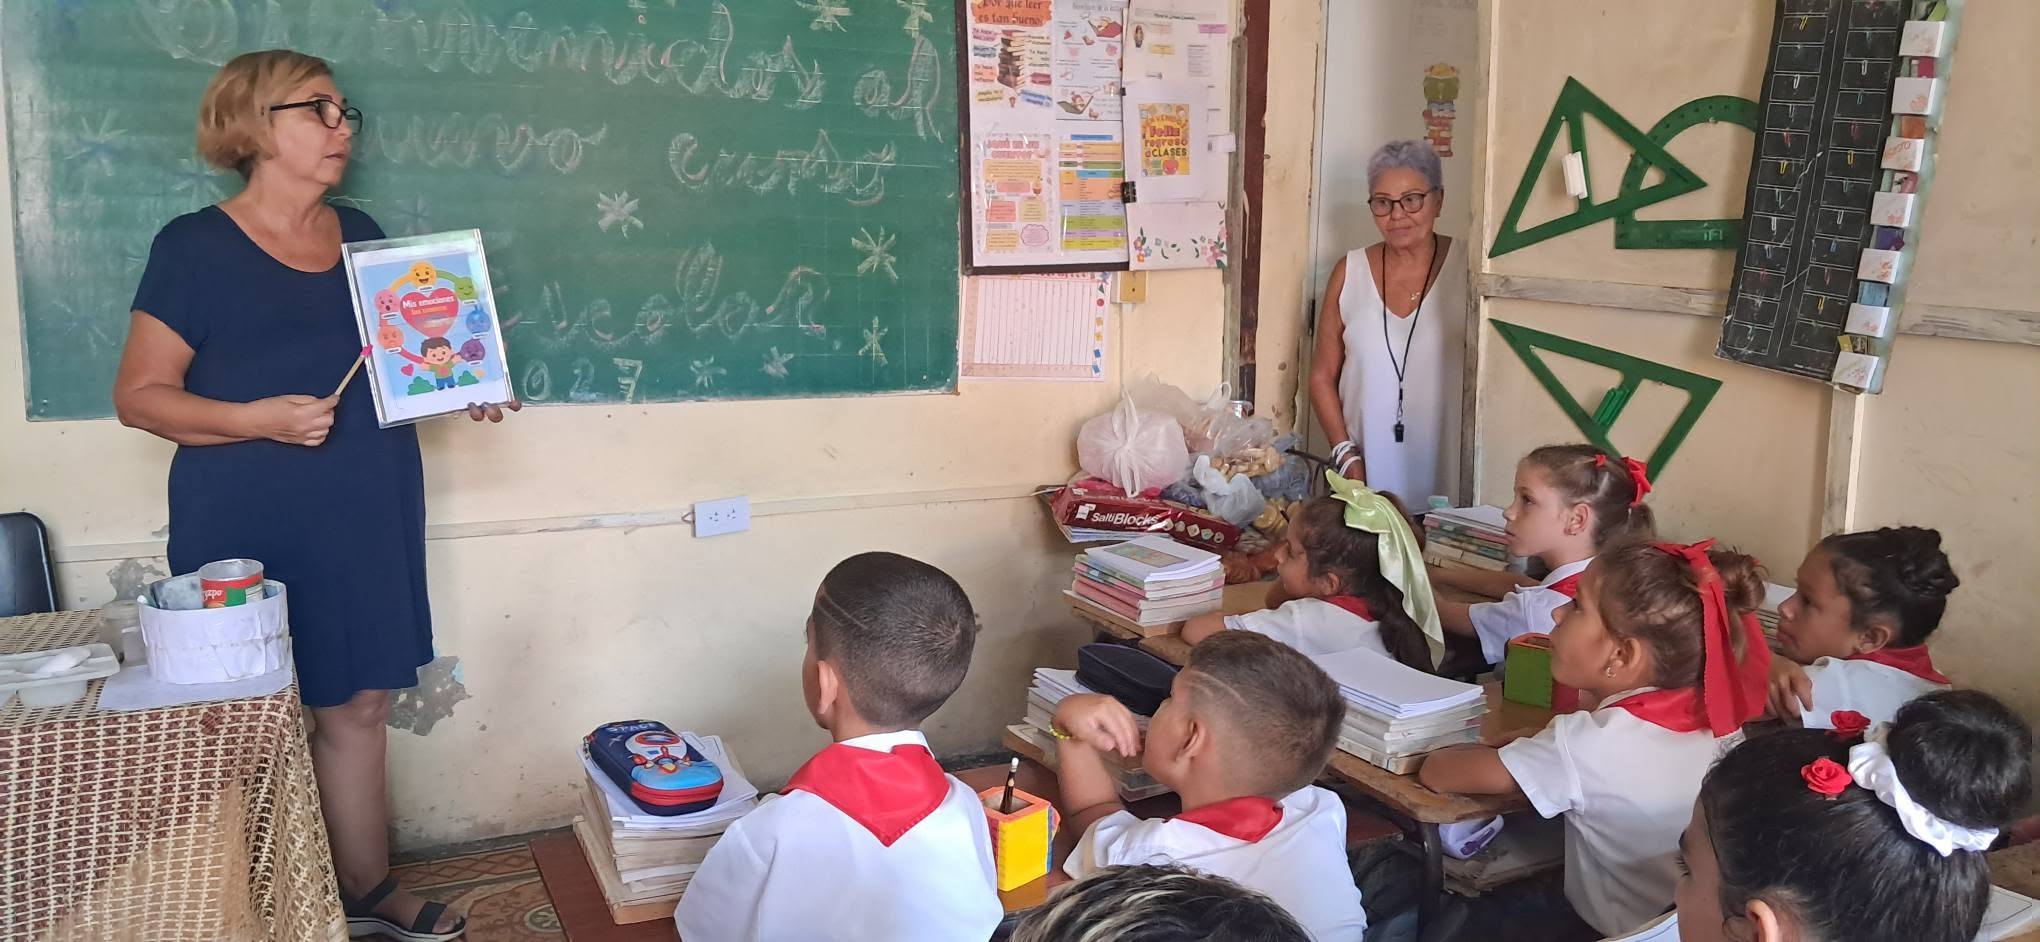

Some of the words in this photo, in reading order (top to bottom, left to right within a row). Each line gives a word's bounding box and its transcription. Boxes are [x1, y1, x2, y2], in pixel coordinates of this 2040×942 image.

[1151, 147, 1187, 157] CLASES
[402, 299, 417, 309] Mis
[1091, 511, 1161, 527] SaltiBlocks
